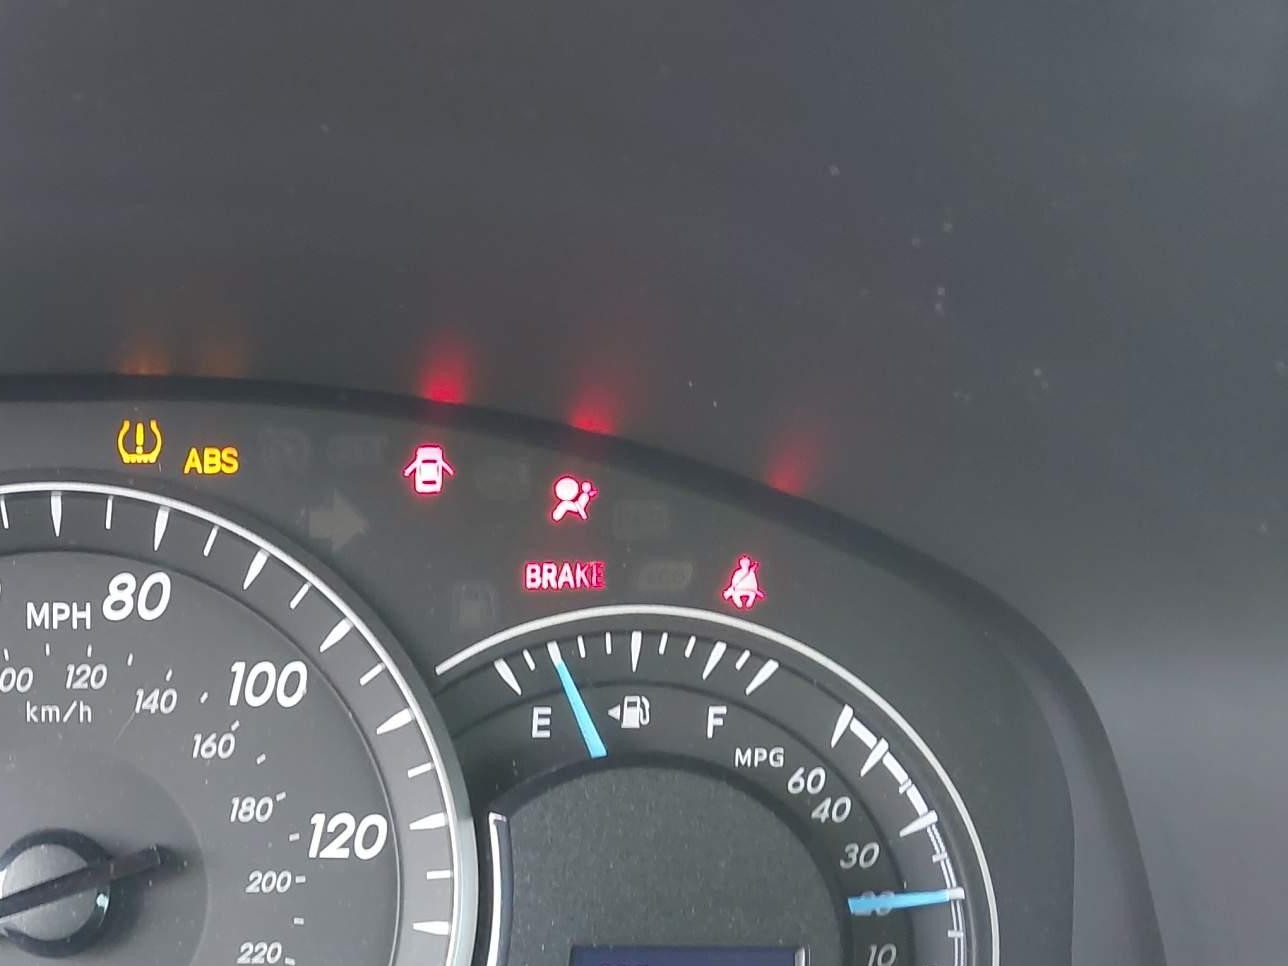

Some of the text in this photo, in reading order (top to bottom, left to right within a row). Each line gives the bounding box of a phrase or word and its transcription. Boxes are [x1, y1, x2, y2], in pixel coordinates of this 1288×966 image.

[184, 447, 238, 473] ABS
[525, 562, 604, 589] BRAKE
[103, 572, 170, 620] 80
[27, 603, 90, 629] MPH
[66, 664, 107, 689] 120
[230, 661, 307, 707] 100
[27, 701, 91, 722] km/h
[136, 689, 177, 713] 140
[532, 707, 551, 737] E
[708, 706, 726, 738] F
[193, 734, 235, 758] 160
[735, 748, 783, 767] MPG
[788, 768, 825, 793] 60
[231, 797, 273, 822] 180
[812, 797, 851, 822] 40
[309, 813, 387, 859] 120
[840, 843, 879, 867] 30
[246, 871, 291, 892] 200
[238, 943, 281, 963] 220
